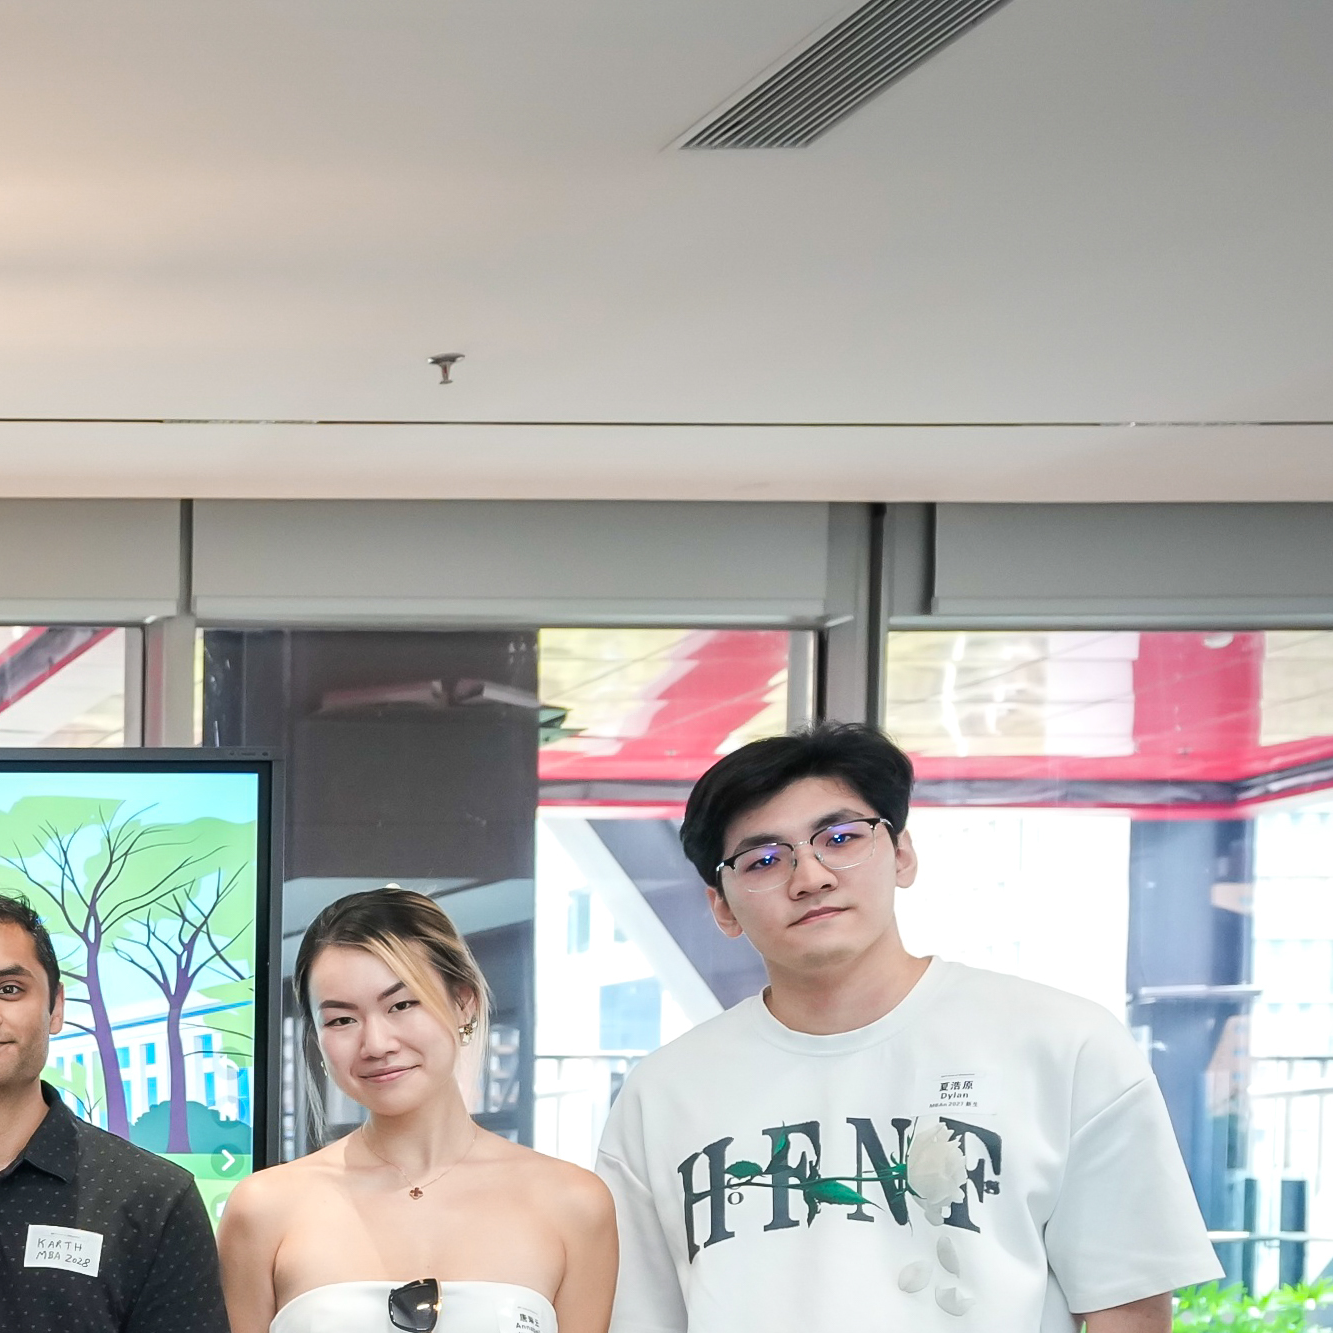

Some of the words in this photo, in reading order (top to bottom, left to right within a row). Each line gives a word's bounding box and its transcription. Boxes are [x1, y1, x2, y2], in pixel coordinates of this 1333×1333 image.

[940, 1092, 969, 1100] Dylan
[36, 1251, 61, 1260] MBA
[65, 1254, 91, 1268] 2028
